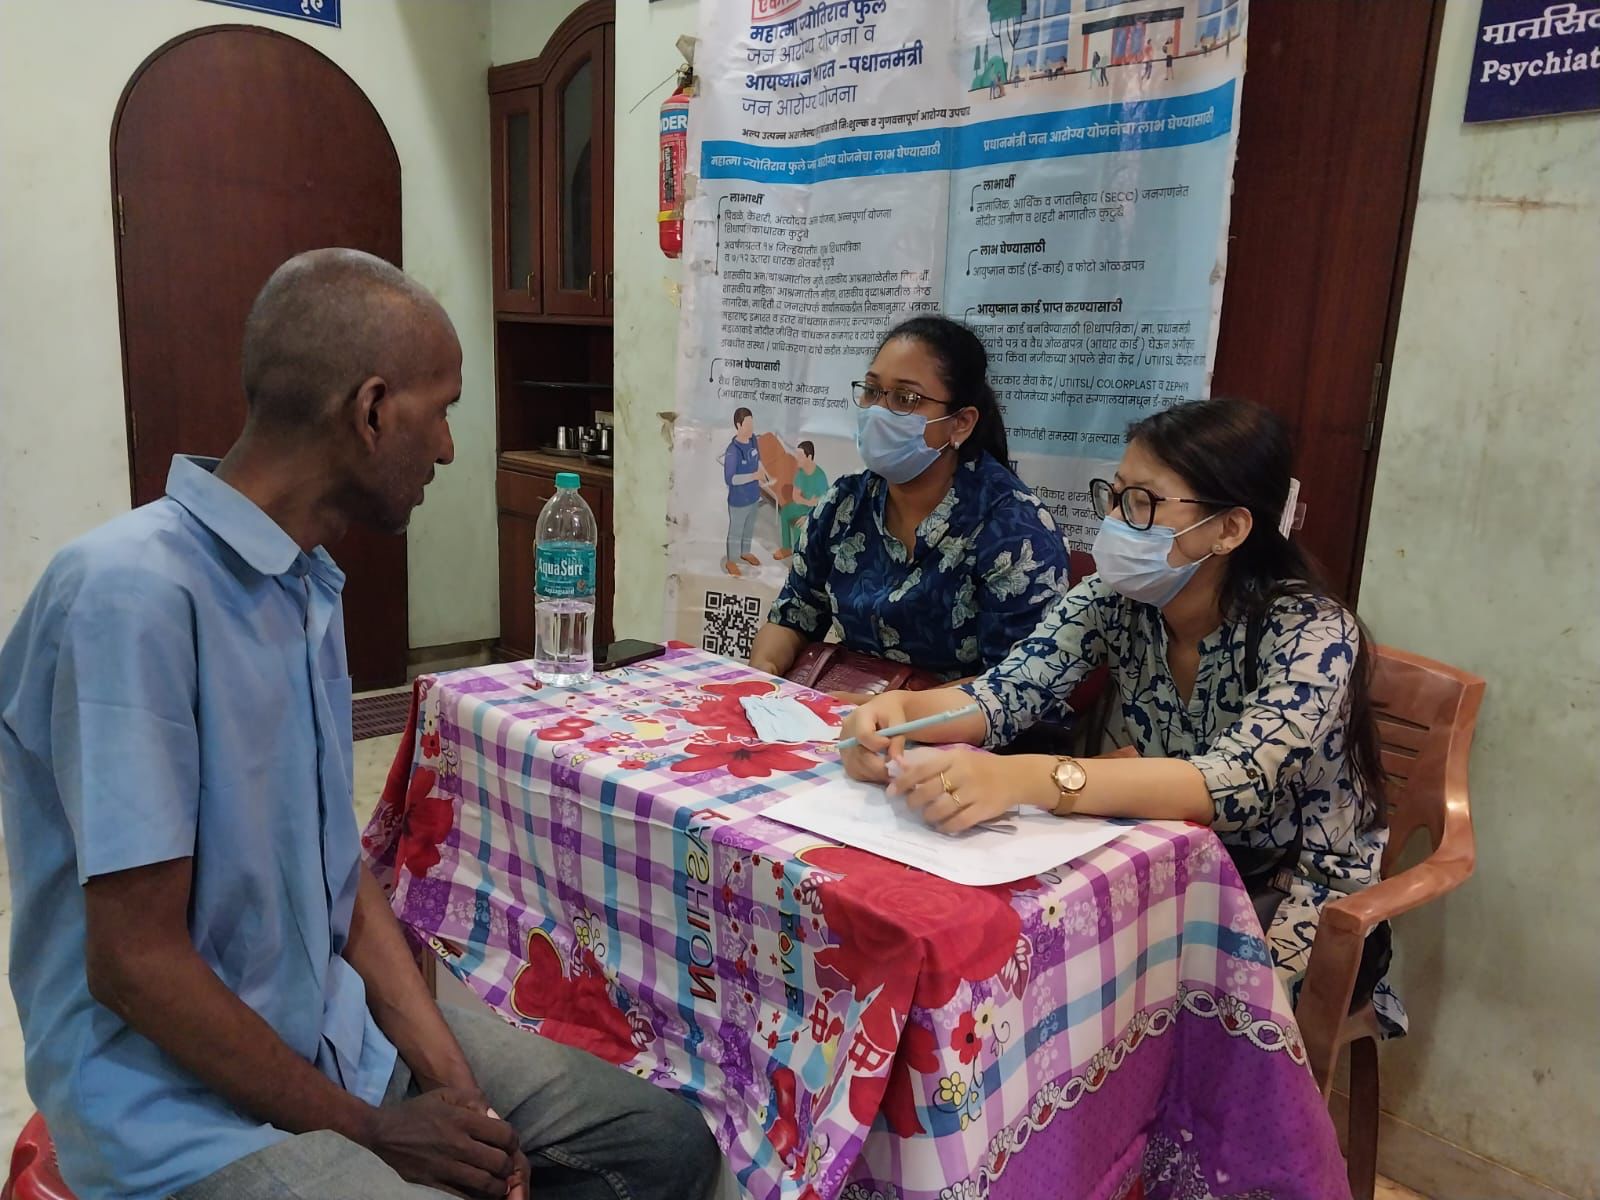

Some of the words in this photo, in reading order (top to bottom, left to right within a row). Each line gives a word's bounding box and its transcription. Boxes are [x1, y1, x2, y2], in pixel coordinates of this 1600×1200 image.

[747, 47, 776, 65] जन
[863, 24, 877, 43] व
[741, 98, 773, 117] जन
[980, 244, 998, 256] लाभ
[1000, 238, 1046, 254] घेण्यासाठी
[977, 302, 1019, 318] आयुष्मान
[1021, 299, 1042, 314] कार्ड
[1043, 301, 1063, 314] प्राप्त
[1065, 297, 1123, 314] करण्यासाठी
[1096, 378, 1156, 391] COLORPLAST
